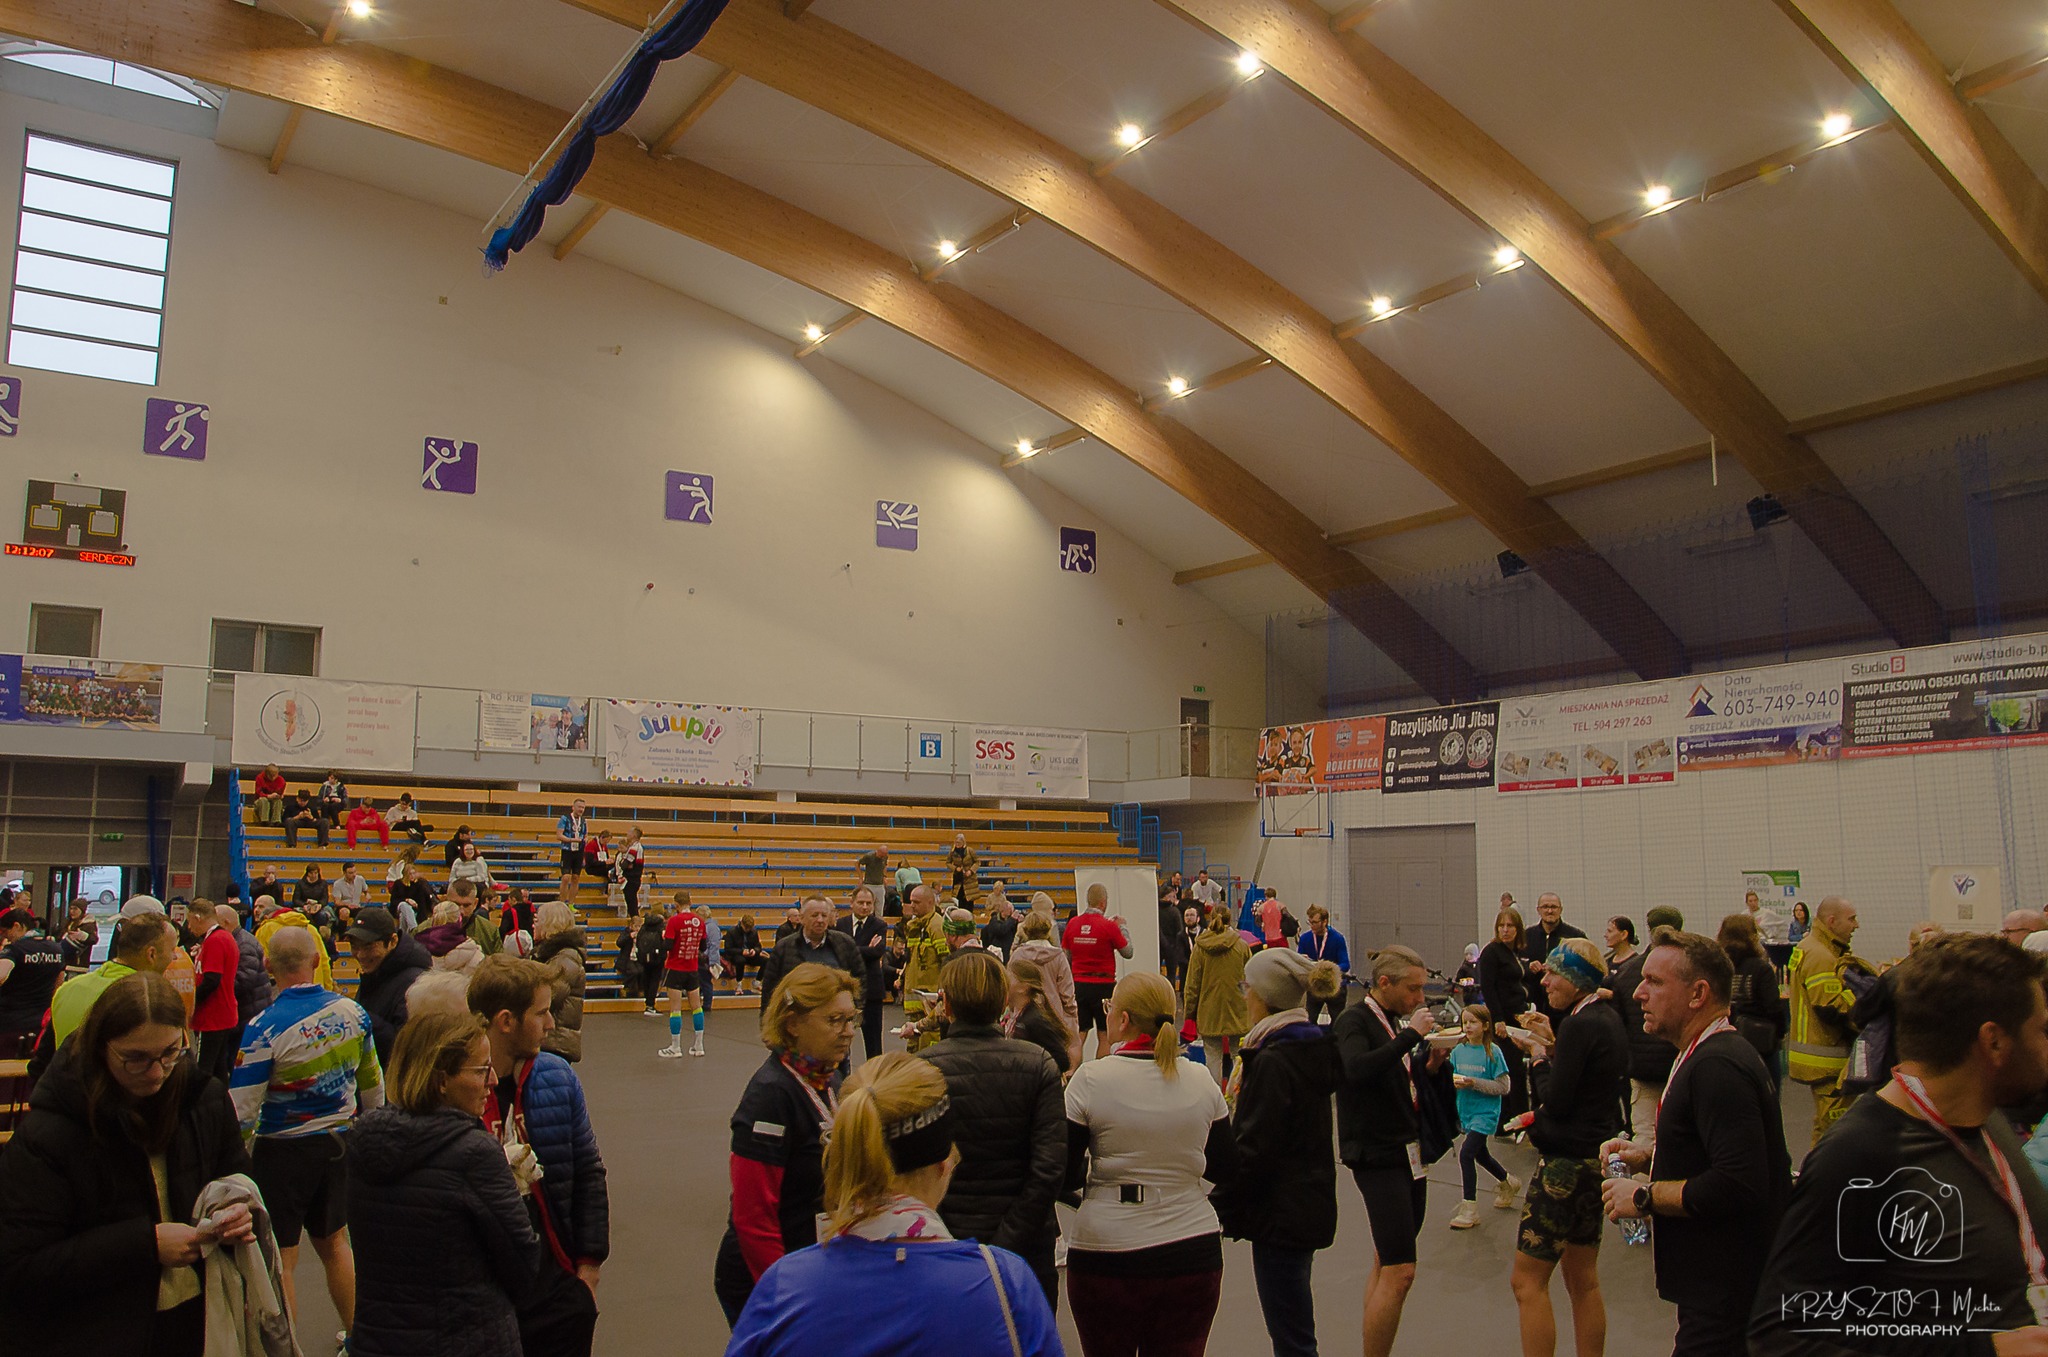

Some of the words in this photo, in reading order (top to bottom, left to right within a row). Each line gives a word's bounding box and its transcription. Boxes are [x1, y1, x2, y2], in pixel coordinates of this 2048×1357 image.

[5, 544, 54, 558] 12:12:07
[79, 552, 132, 566] SERDECZN
[1851, 661, 1889, 675] Studio
[1724, 675, 1751, 686] Data
[1724, 680, 1803, 698] Nieruchomości
[1851, 679, 1926, 696] KOMPLEKSOWA
[1928, 673, 1978, 688] OBSŁUGA
[1559, 701, 1608, 714] MIESZKANIA
[1611, 700, 1623, 709] NA
[1625, 694, 1669, 707] SPRZEDAŻ
[1724, 689, 1839, 717] 603-749-940
[1855, 700, 1875, 709] DRUK
[1506, 718, 1546, 728] STORK
[1689, 721, 1733, 733] SPRZEDAŻ
[1740, 717, 1773, 728] KUPNO
[1782, 711, 1831, 723] WYNAJEM
[1855, 710, 1875, 718] DRUK
[639, 714, 723, 744] Juupi!
[1390, 715, 1448, 738] Brazylijskie
[1450, 713, 1466, 730] Jiu
[1468, 711, 1495, 728] Jitsu
[1572, 722, 1590, 732] TEL.
[1594, 719, 1611, 730] 504
[1613, 718, 1630, 729] 297
[1633, 716, 1652, 727] 263
[925, 741, 936, 757] B
[975, 739, 1015, 761] SOS
[1326, 757, 1379, 772] ROKIETNICA
